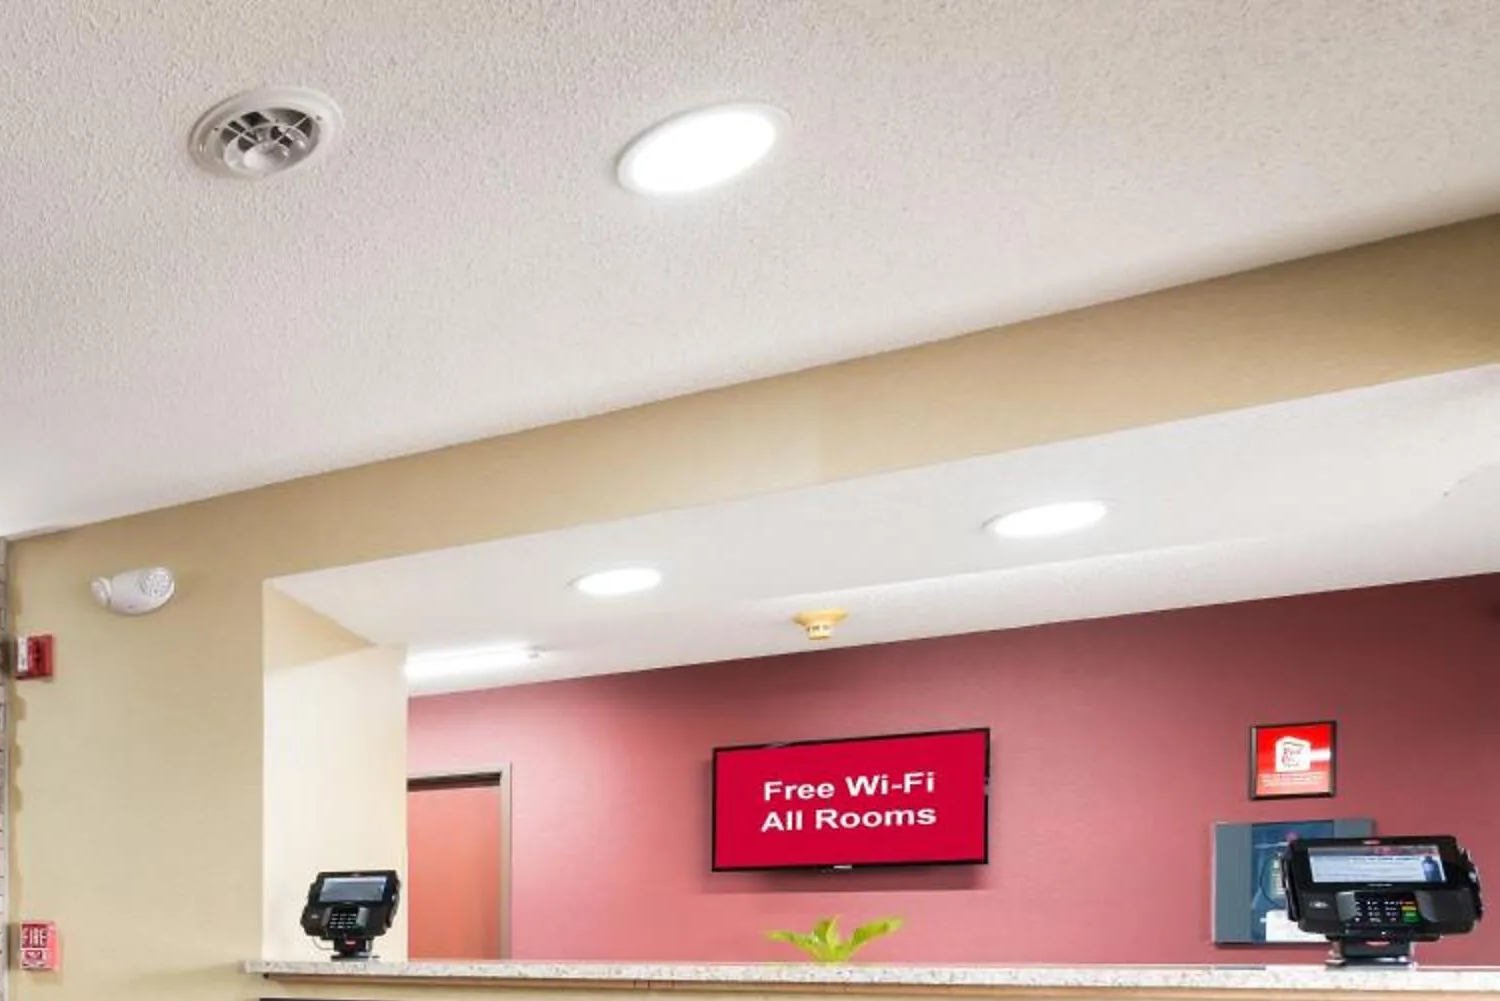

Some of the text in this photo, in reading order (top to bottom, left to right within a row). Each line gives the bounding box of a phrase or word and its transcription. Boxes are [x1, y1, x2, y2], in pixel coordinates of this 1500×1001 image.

[764, 772, 935, 801] Free Wi-Fi
[761, 808, 937, 832] All Rooms
